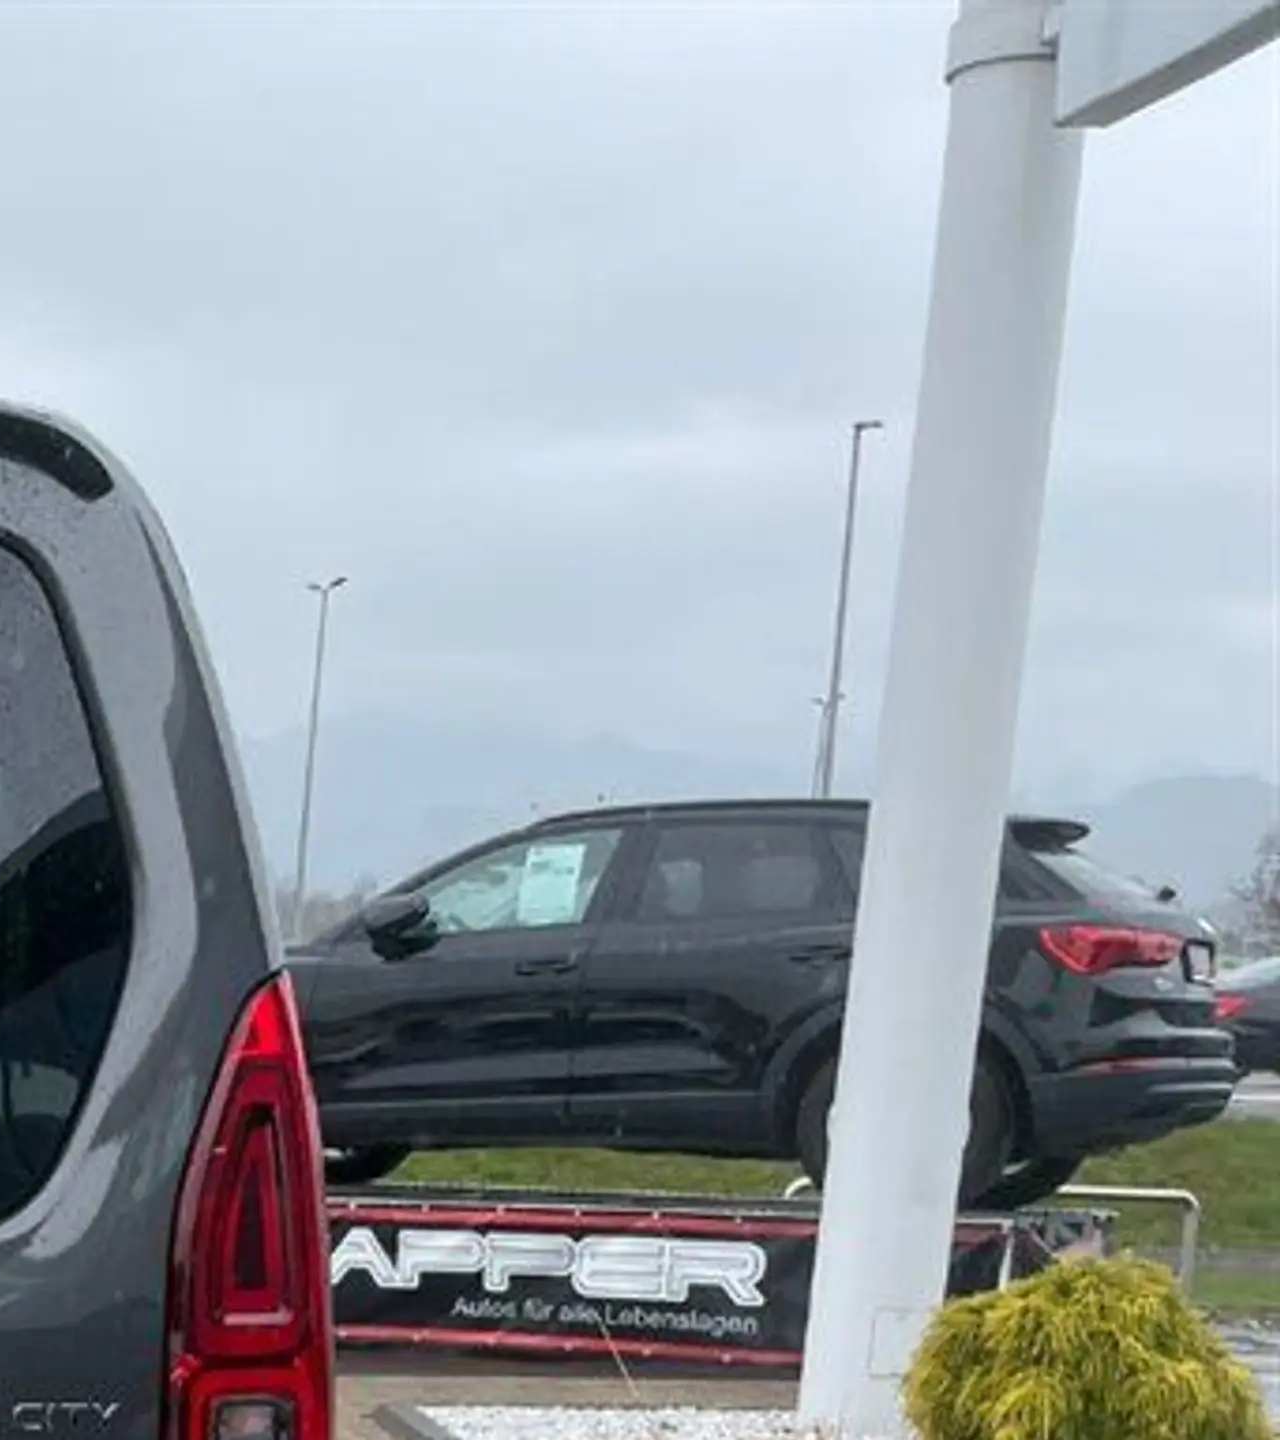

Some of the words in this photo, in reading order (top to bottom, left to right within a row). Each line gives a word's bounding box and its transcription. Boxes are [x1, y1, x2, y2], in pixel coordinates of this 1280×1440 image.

[331, 1226, 768, 1307] APPER
[450, 1296, 516, 1319] Autos
[522, 1297, 555, 1322] für
[559, 1303, 598, 1324] alle
[604, 1302, 758, 1335] Lebenslagen
[12, 1401, 122, 1432] CITY
